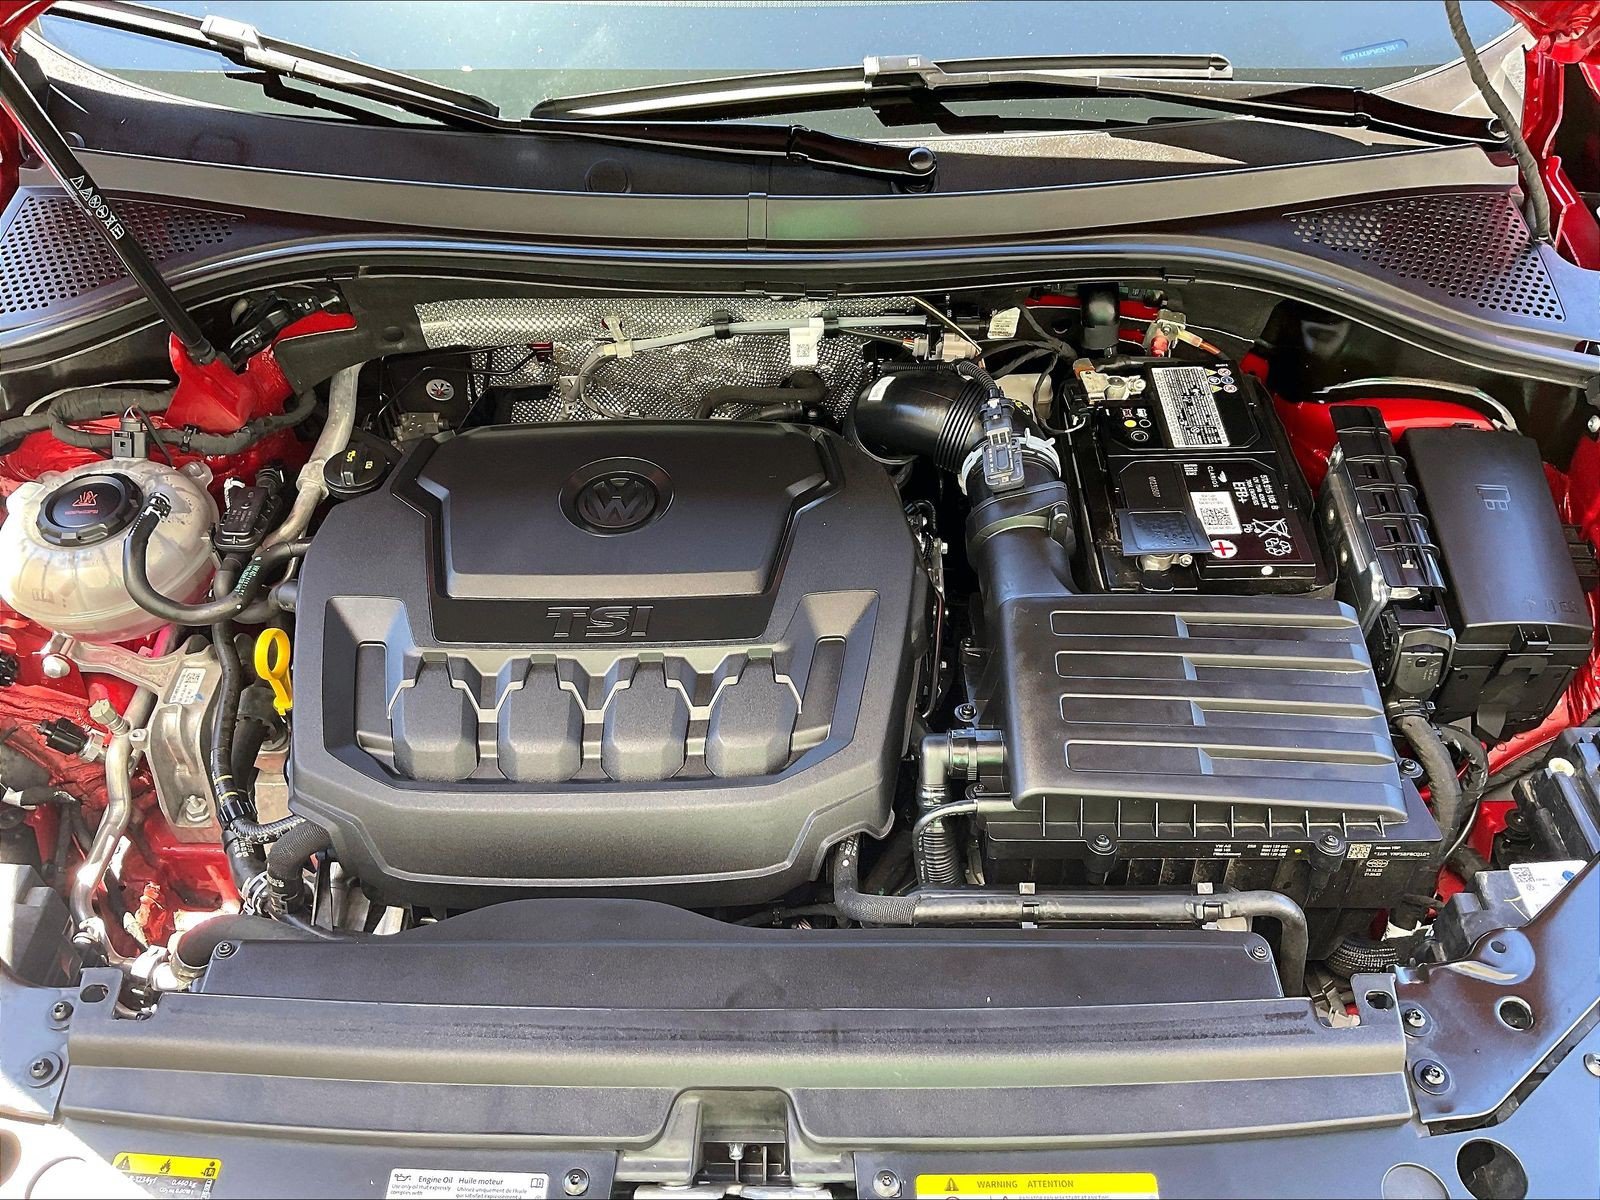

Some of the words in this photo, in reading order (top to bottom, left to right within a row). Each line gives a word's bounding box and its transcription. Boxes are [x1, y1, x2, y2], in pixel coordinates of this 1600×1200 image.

[1207, 465, 1220, 488] CLARIOS
[1232, 482, 1249, 504] EFB+
[546, 605, 654, 638] TSI
[418, 1176, 442, 1185] Engine
[458, 1177, 477, 1185] Huile
[977, 1180, 1018, 1188] WARNING
[1027, 1180, 1074, 1188] ATTENTION
